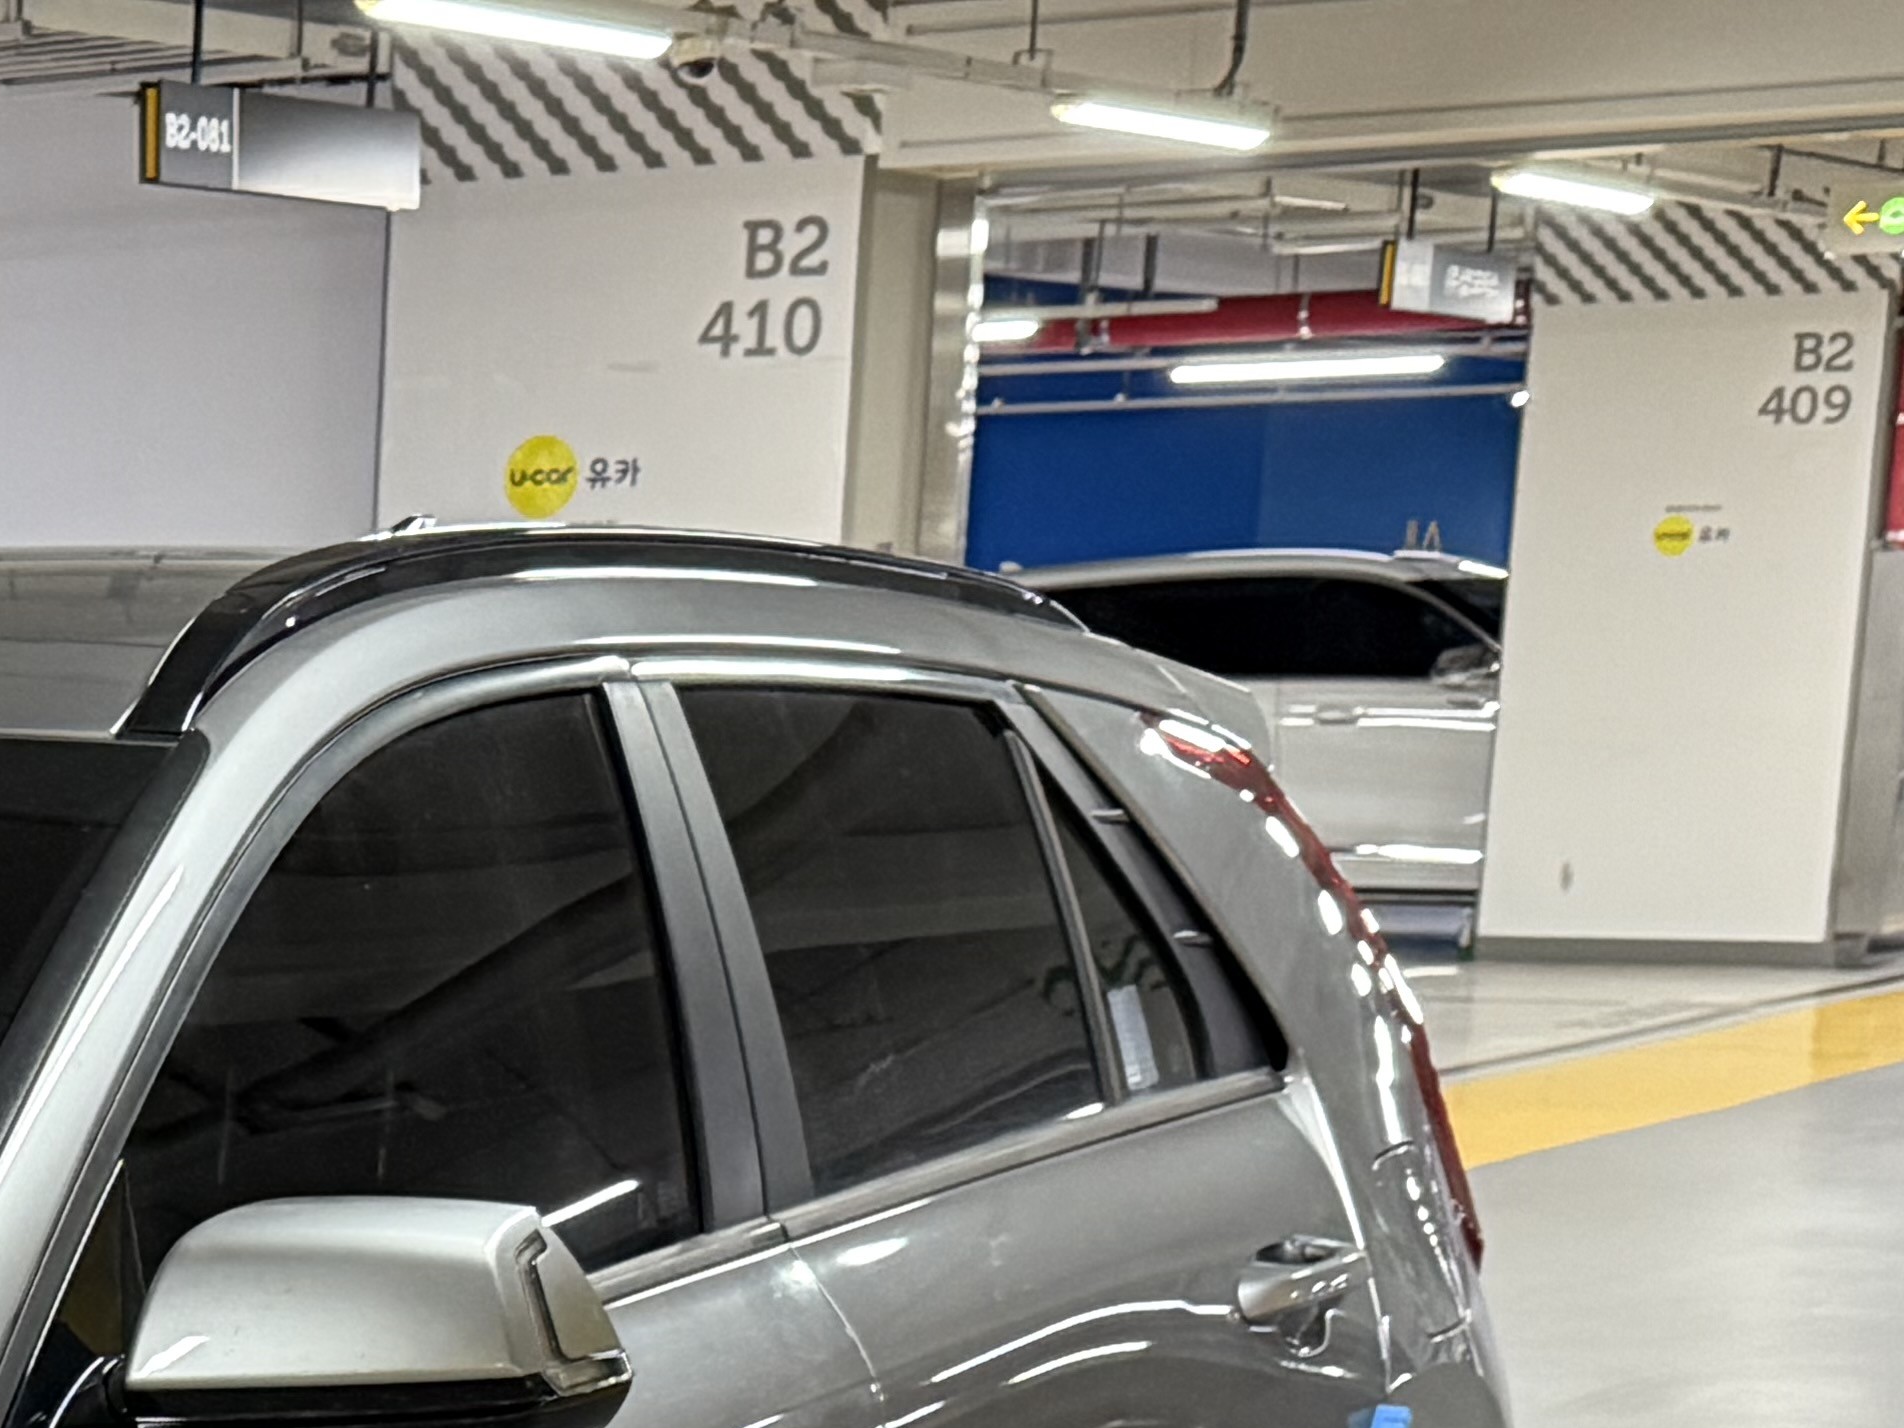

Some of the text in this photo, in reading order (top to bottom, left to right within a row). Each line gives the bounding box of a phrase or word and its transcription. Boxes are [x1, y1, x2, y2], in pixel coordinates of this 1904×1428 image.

[165, 112, 231, 152] B2-081
[742, 215, 830, 279] B2
[698, 296, 822, 359] 410
[1794, 331, 1854, 372] B2
[1757, 384, 1852, 425] 409
[585, 457, 641, 490] 유카
